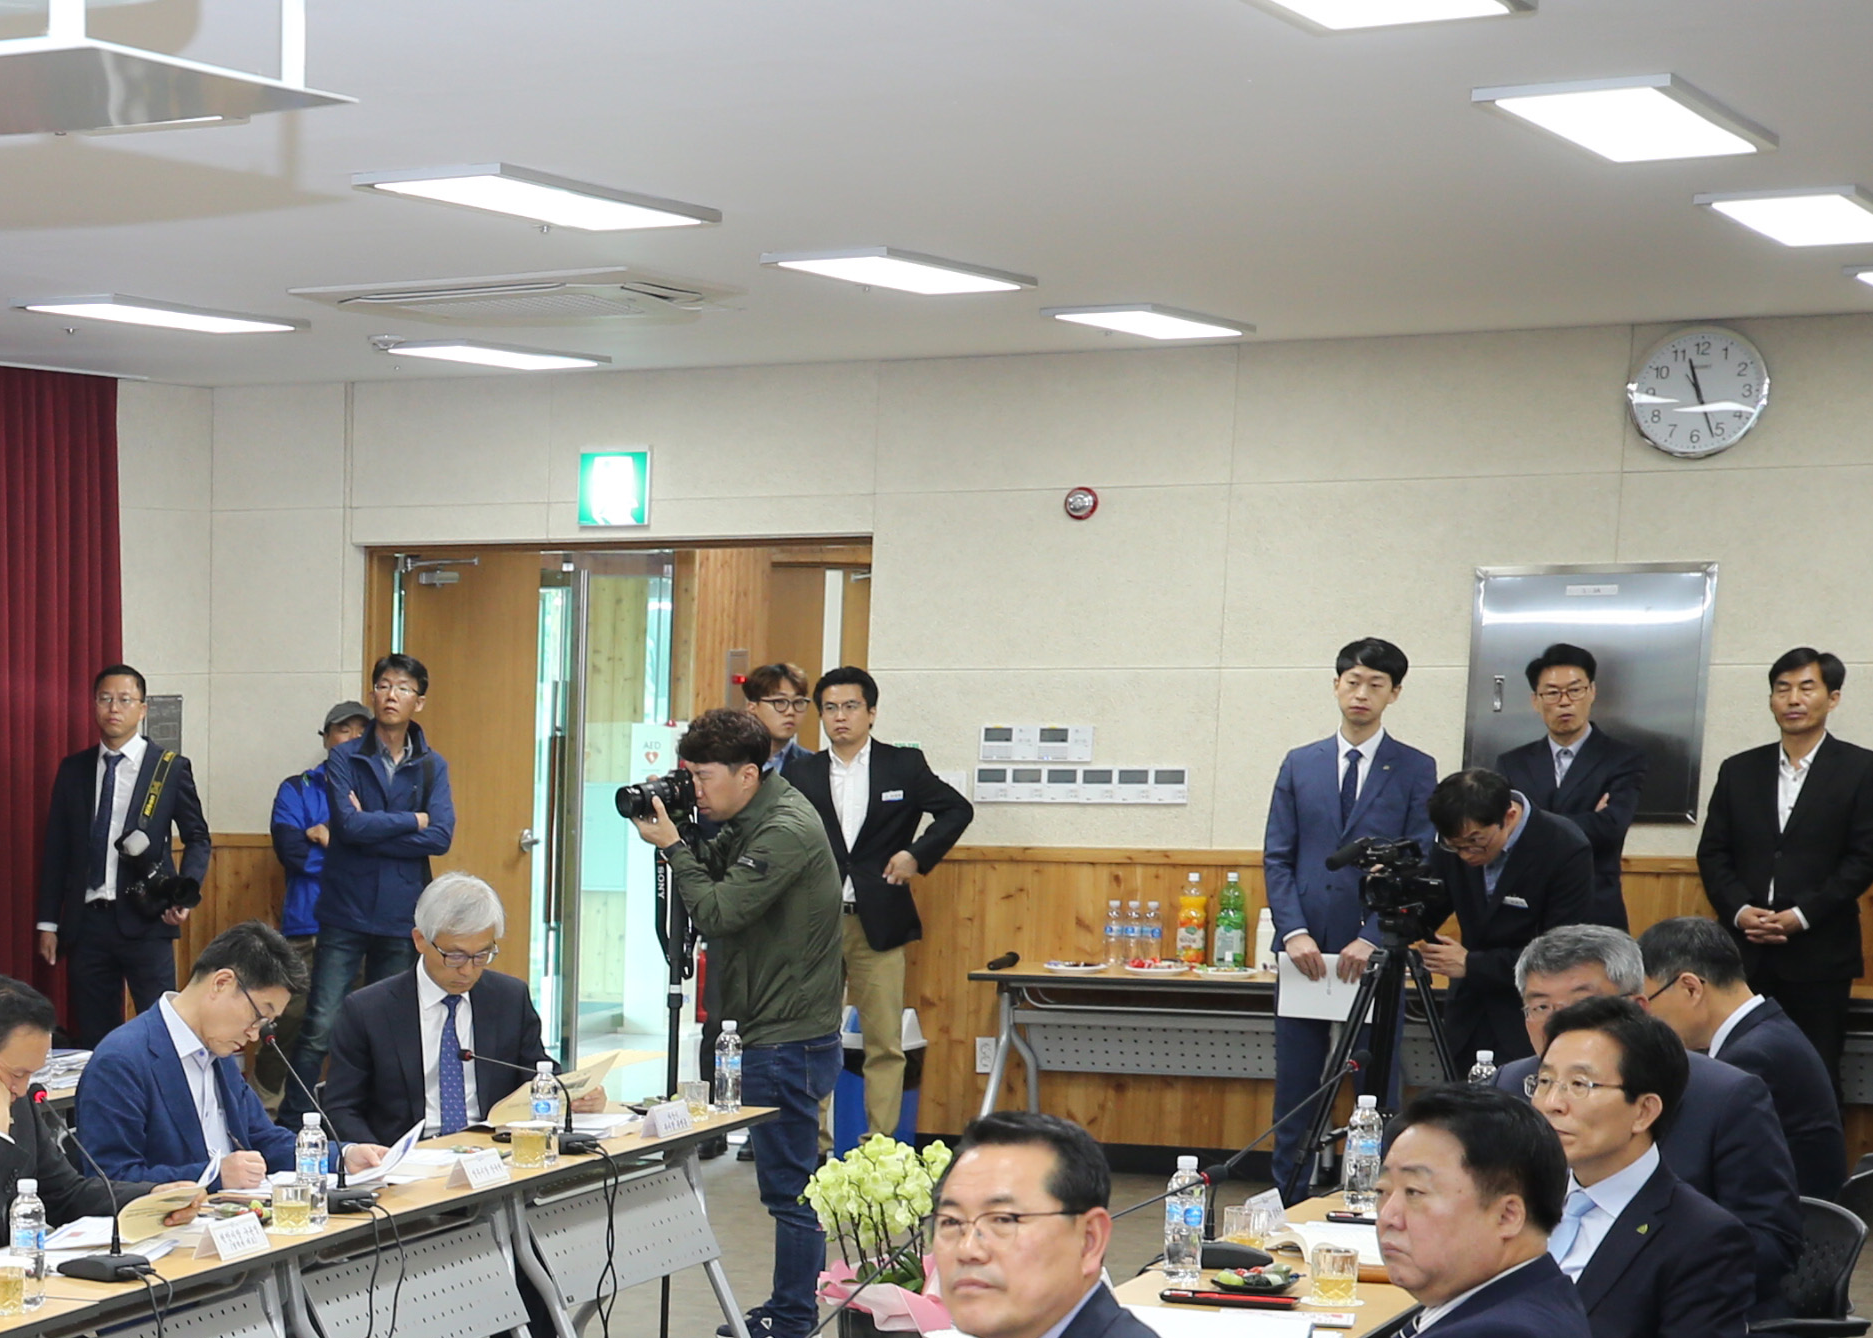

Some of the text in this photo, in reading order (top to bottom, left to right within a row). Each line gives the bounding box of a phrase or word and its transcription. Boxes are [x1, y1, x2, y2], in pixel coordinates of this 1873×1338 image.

[1672, 349, 1687, 361] 11
[1694, 341, 1711, 355] 12
[1722, 346, 1729, 360] 1
[1654, 365, 1670, 379] 10
[1736, 361, 1748, 377] 2
[1741, 383, 1752, 398] 3
[1650, 409, 1661, 423] 8
[1668, 424, 1678, 438] 7
[1689, 429, 1700, 444] 6
[1714, 422, 1725, 437] 5
[643, 741, 662, 750] AED
[657, 866, 666, 900] SONY
